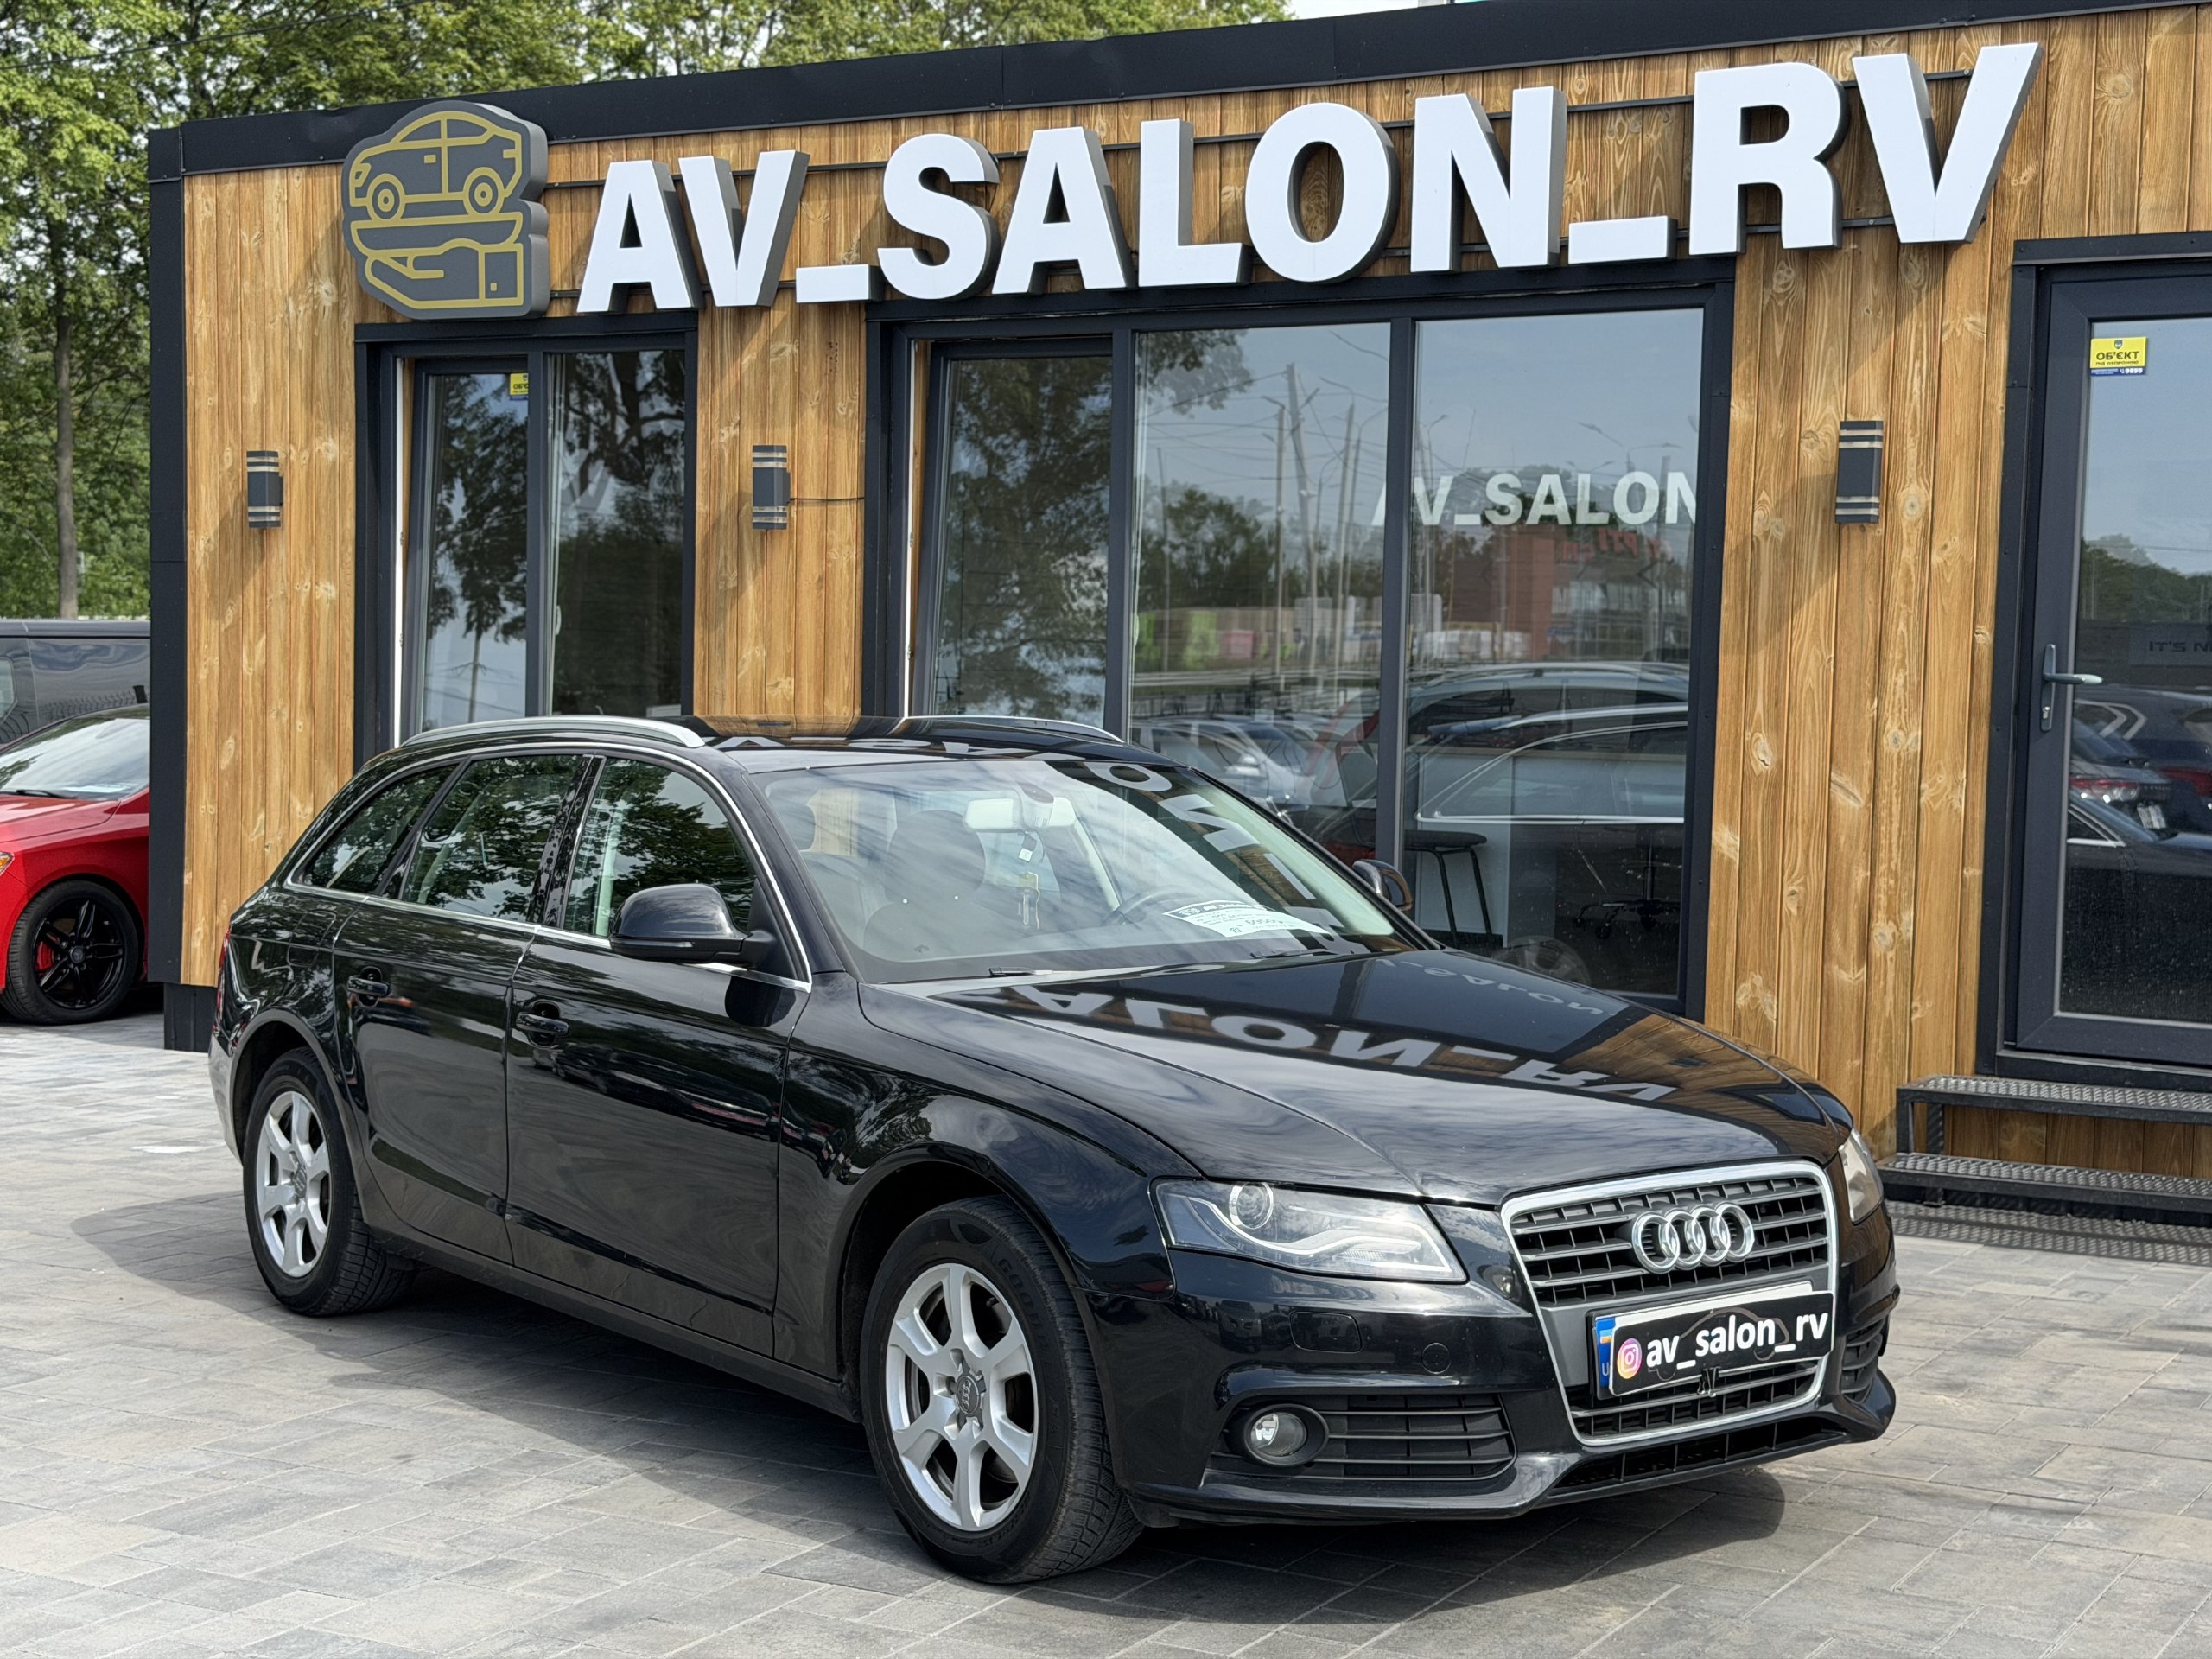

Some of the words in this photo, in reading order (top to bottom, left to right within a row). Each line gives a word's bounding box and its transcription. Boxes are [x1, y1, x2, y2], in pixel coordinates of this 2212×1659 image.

[576, 42, 2040, 314] AV_SALON_RV
[2096, 351, 2139, 360] ОБ'ЄКТ
[2149, 641, 2186, 652] IT'S
[1646, 1313, 1828, 1370] av_salon_rv
